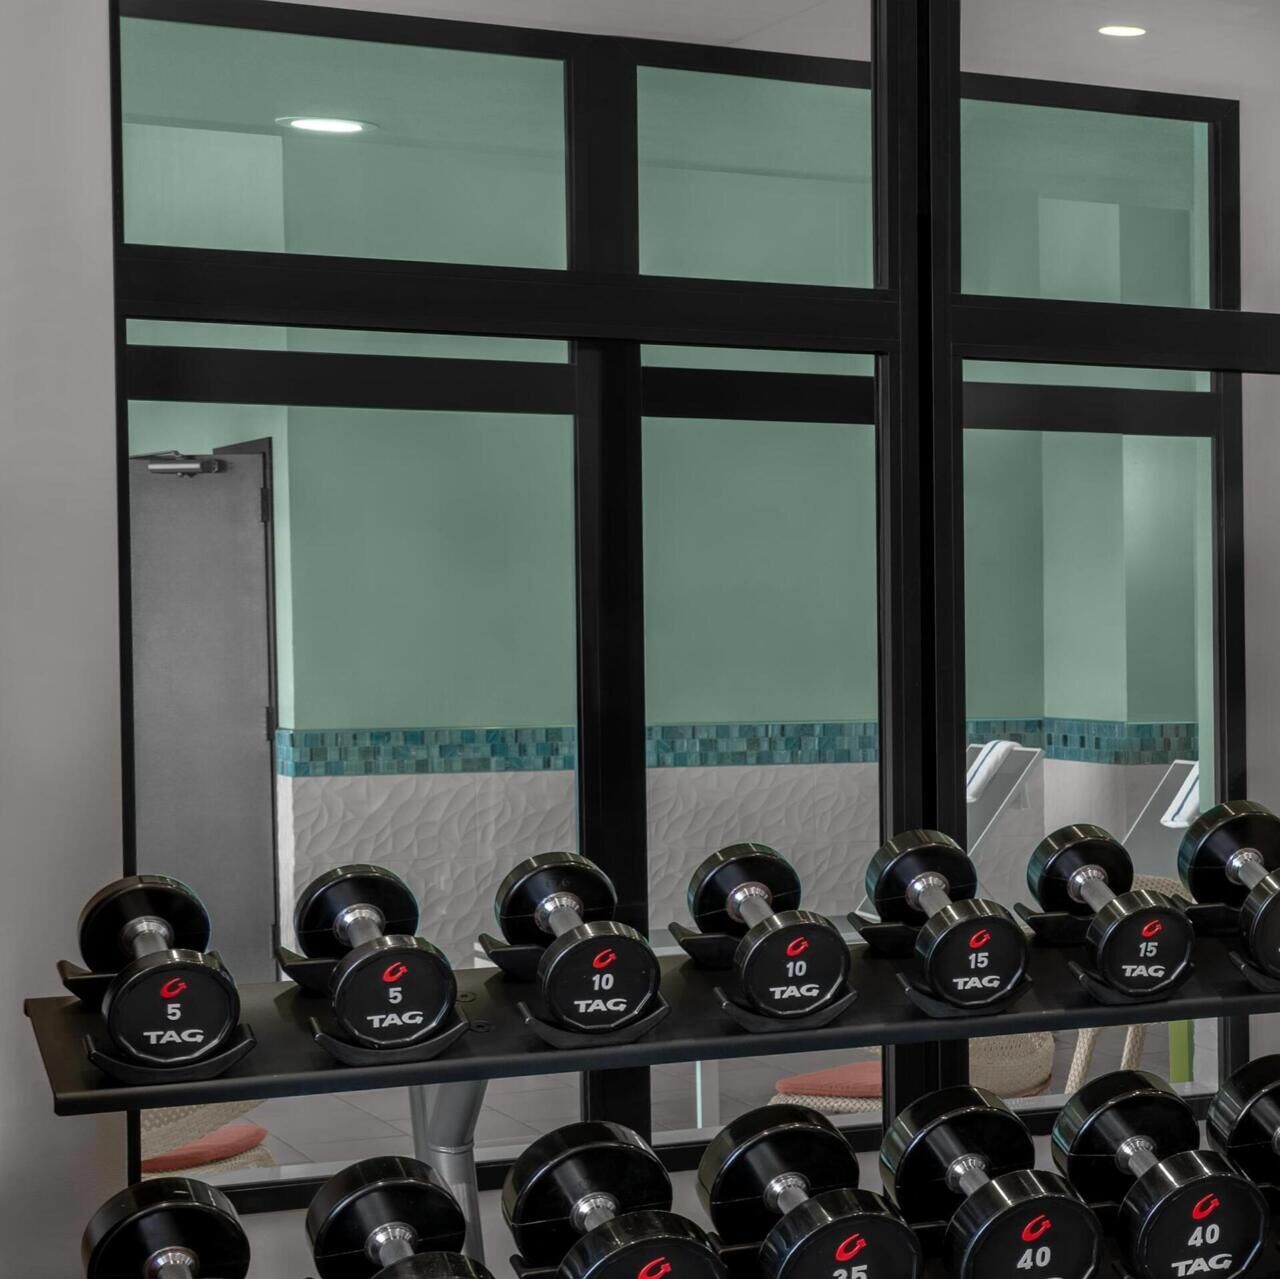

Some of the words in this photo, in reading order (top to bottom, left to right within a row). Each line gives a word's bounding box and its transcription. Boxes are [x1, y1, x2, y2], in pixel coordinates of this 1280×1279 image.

[1139, 941, 1159, 958] 15
[786, 960, 807, 978] 10
[968, 951, 989, 969] 15
[1121, 964, 1166, 978] TAG
[592, 973, 614, 991] 10
[952, 975, 1001, 991] TAG
[388, 986, 403, 1004] 5
[769, 983, 820, 1000] TAG
[166, 1003, 182, 1021] 5
[573, 998, 628, 1013] TAG
[366, 1010, 424, 1029] TAG
[143, 1028, 205, 1045] TAG
[1187, 1223, 1220, 1247] 40
[1016, 1246, 1051, 1270] 40
[1170, 1253, 1233, 1278] TAG
